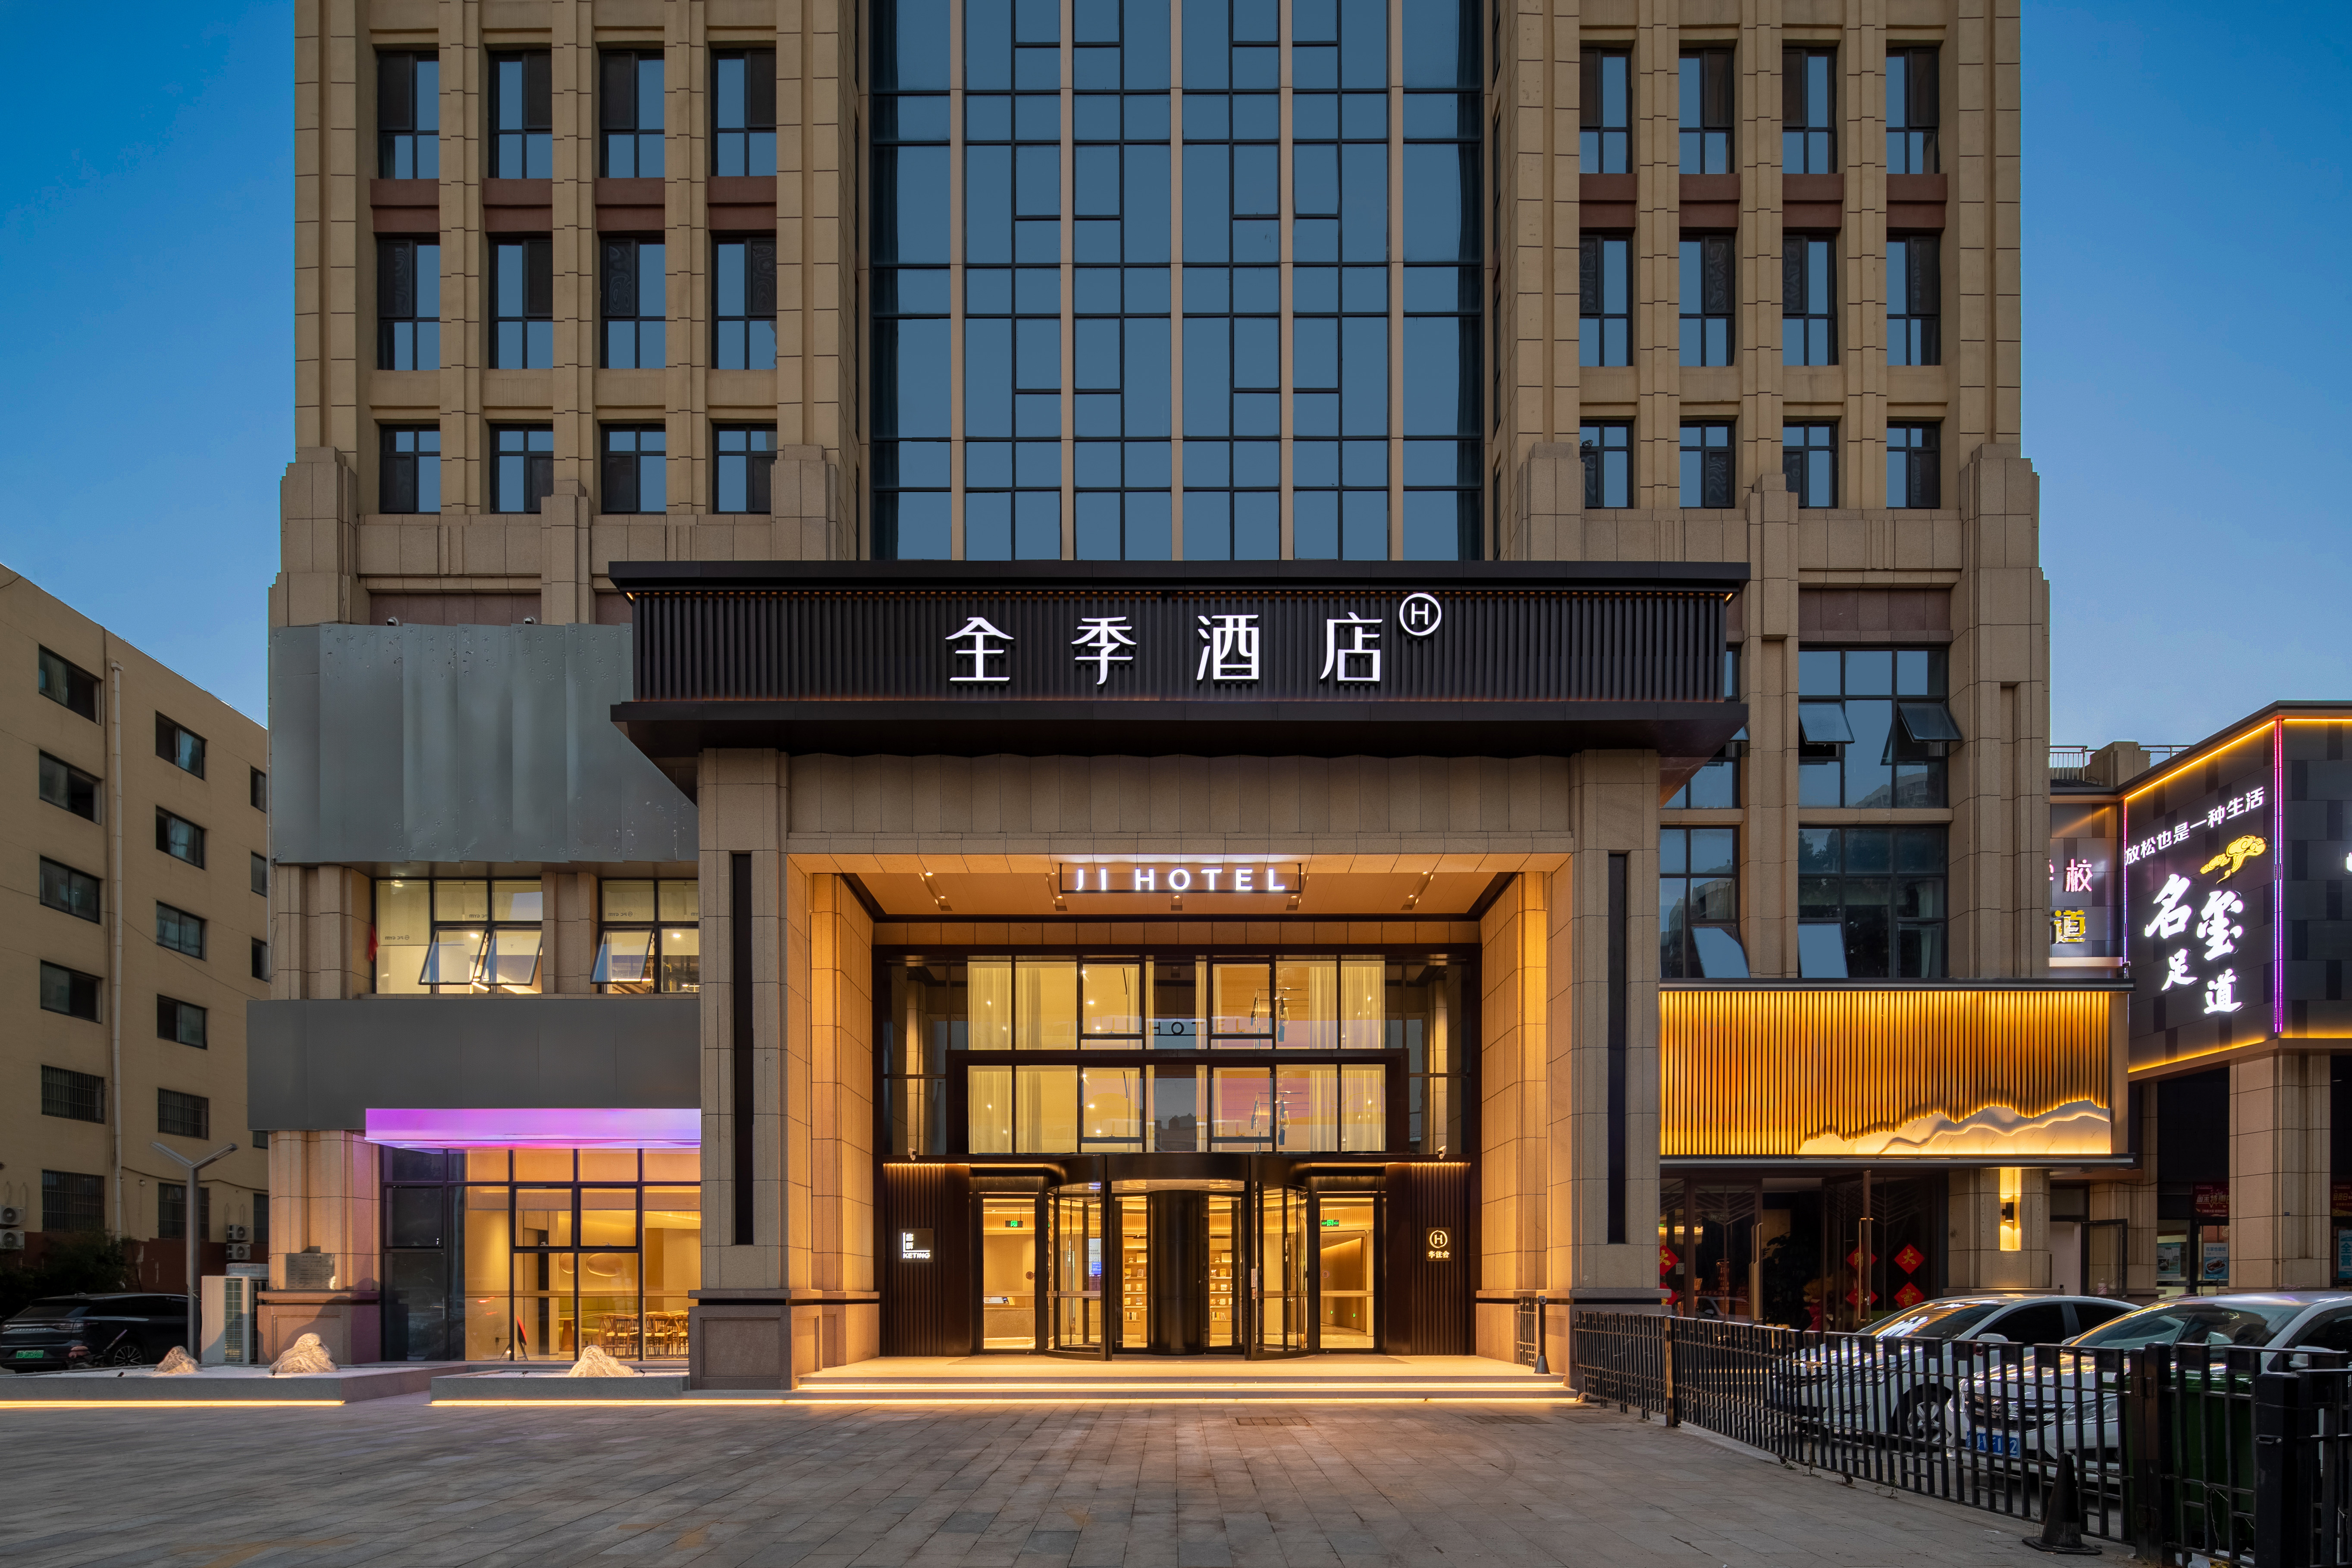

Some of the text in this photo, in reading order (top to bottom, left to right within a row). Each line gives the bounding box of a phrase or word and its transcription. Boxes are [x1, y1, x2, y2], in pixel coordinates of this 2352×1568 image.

[945, 612, 1383, 684] 全季酒店
[2125, 786, 2264, 865] 放松也是一种生活
[1076, 868, 1286, 891] JI HOTEL
[2049, 859, 2093, 892] 校
[2054, 909, 2086, 944] 道
[2161, 948, 2242, 1014] 足道
[1428, 1250, 1450, 1259] 华住会
[1902, 1248, 1916, 1264] 大
[1900, 1289, 1916, 1306] 吉
